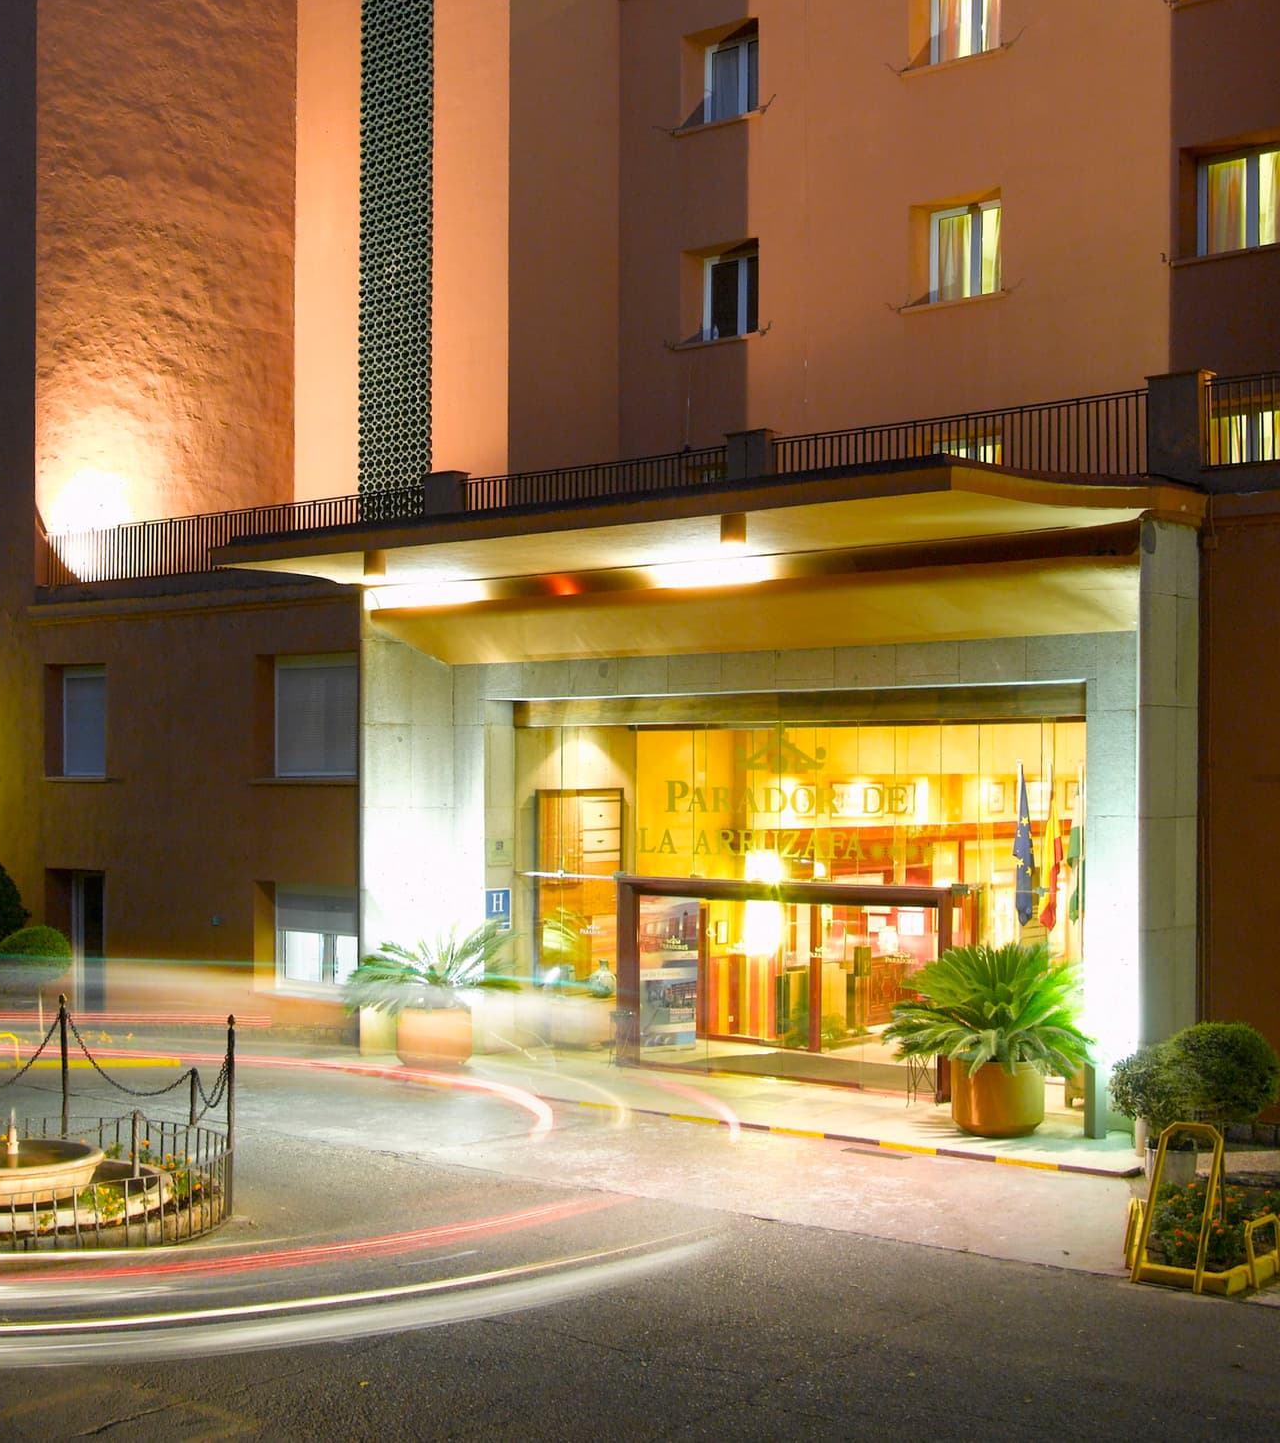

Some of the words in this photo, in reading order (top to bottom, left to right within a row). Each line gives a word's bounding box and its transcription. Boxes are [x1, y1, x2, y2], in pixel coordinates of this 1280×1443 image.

[664, 779, 840, 814] PARADOR
[862, 786, 908, 814] DE
[638, 827, 677, 854] LA
[693, 829, 866, 859] ARRUZAFA
[491, 892, 505, 913] H
